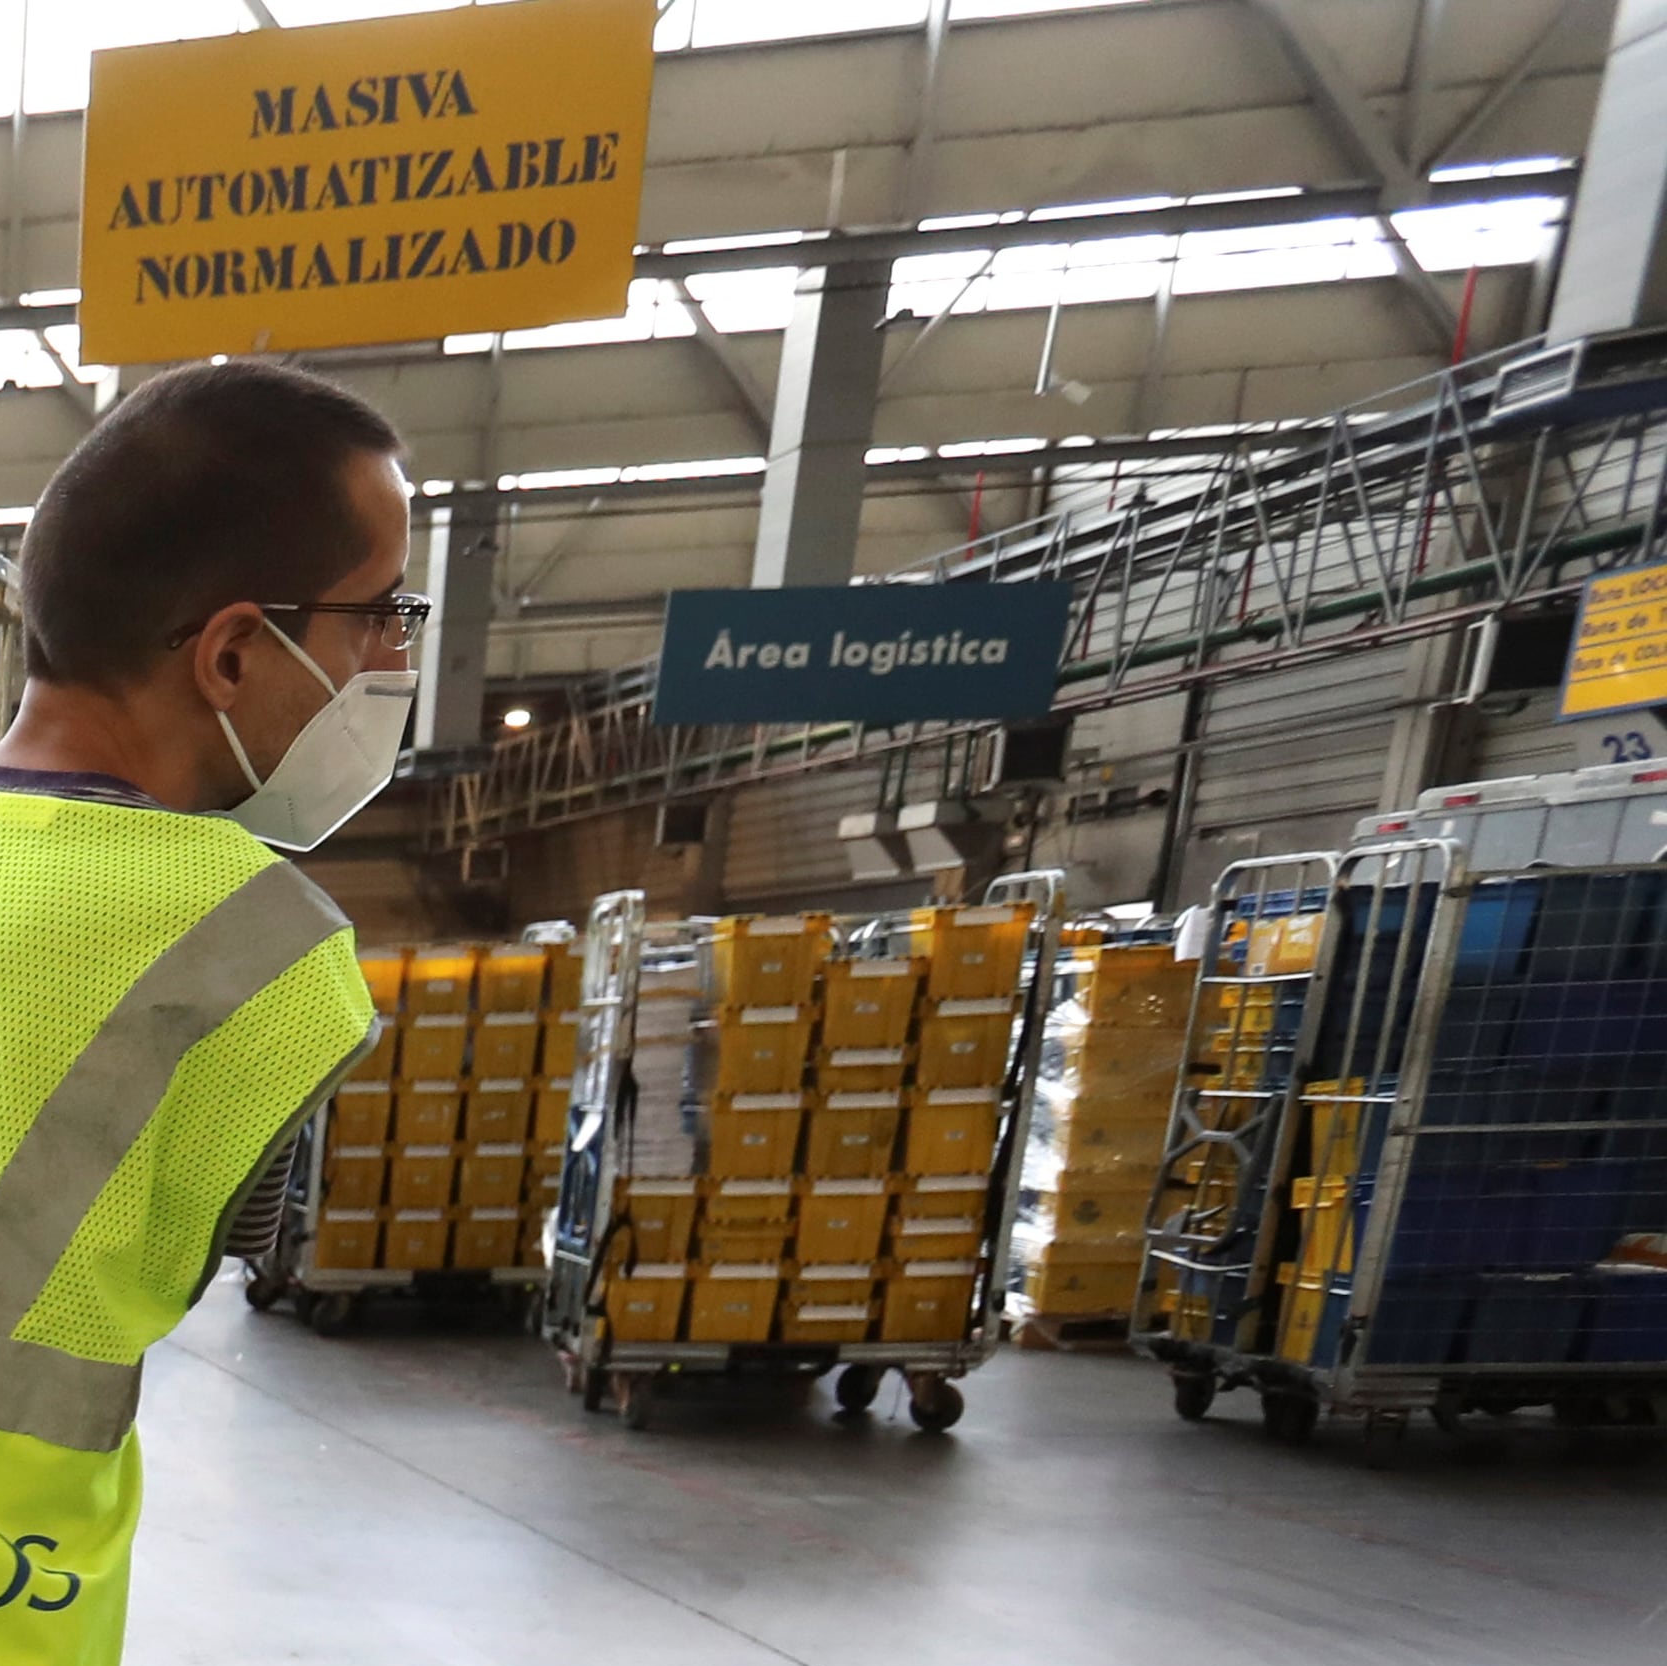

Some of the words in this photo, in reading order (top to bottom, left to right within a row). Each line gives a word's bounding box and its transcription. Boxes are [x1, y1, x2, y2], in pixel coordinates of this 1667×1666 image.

[249, 69, 478, 138] MASIVA
[107, 132, 620, 231] AUTOMATIZABLE
[135, 219, 576, 303] NORMALIZADO
[705, 629, 809, 672] Área
[829, 630, 1009, 676] logística
[1602, 731, 1652, 763] 23
